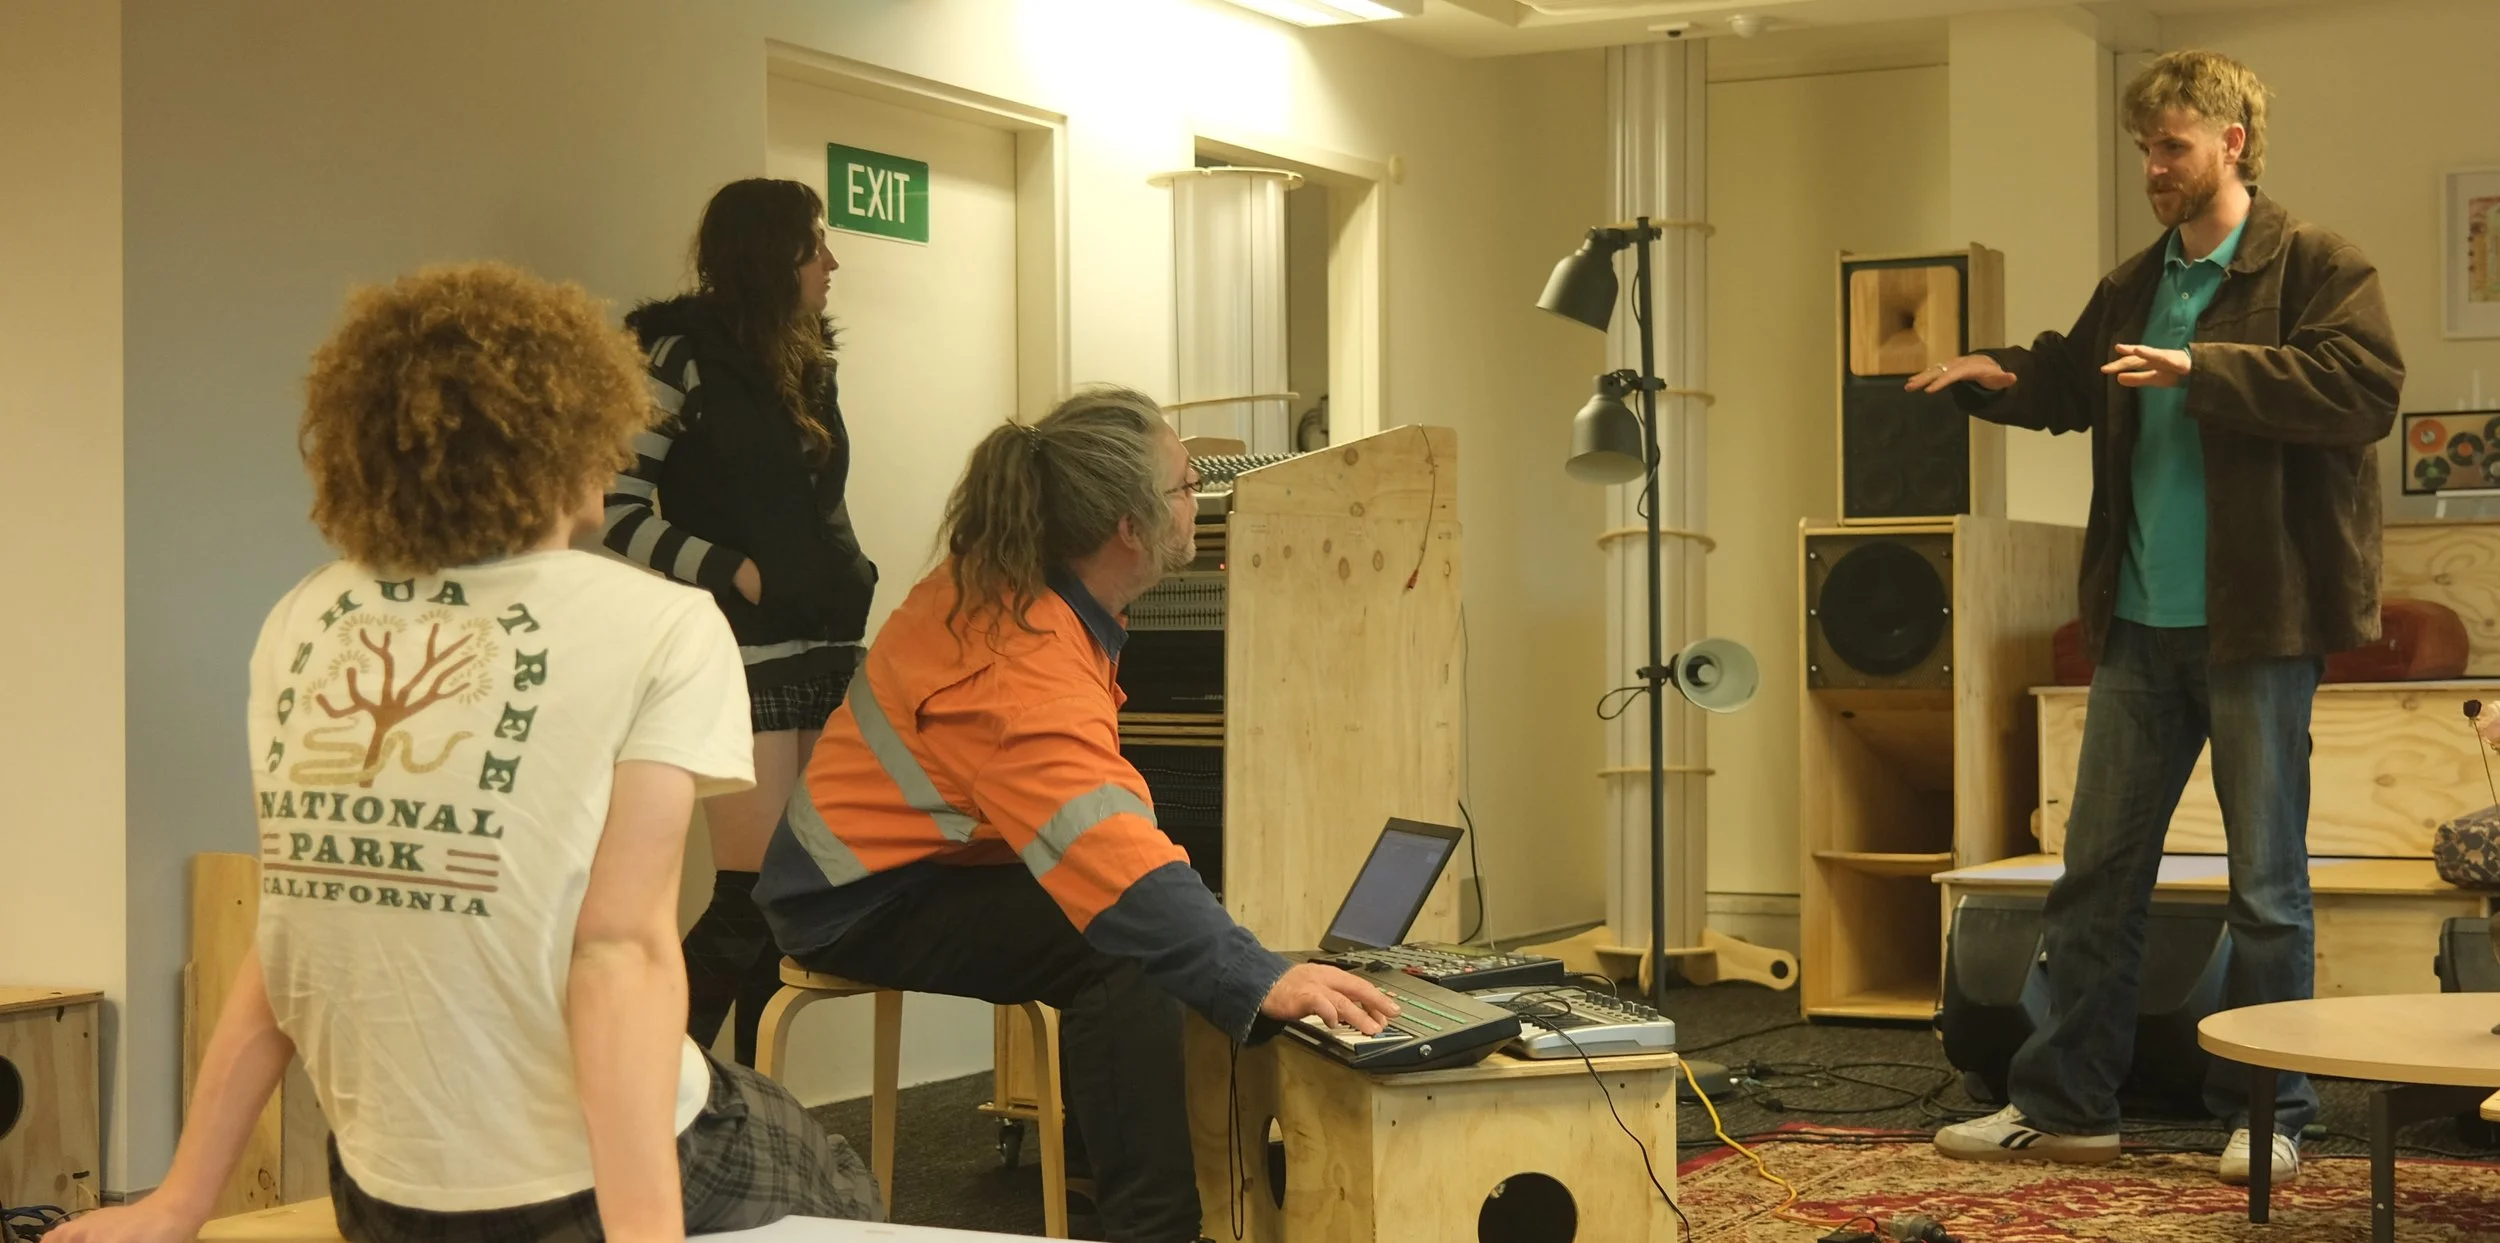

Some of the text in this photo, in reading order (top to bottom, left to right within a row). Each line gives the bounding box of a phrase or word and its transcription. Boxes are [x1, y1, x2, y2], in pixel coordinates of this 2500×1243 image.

[848, 162, 910, 224] EXIT
[266, 578, 549, 793] JOSHUA TREE
[260, 790, 504, 839] NATIONAL
[289, 832, 425, 872] PARK
[263, 876, 491, 917] CALIFORNIA
